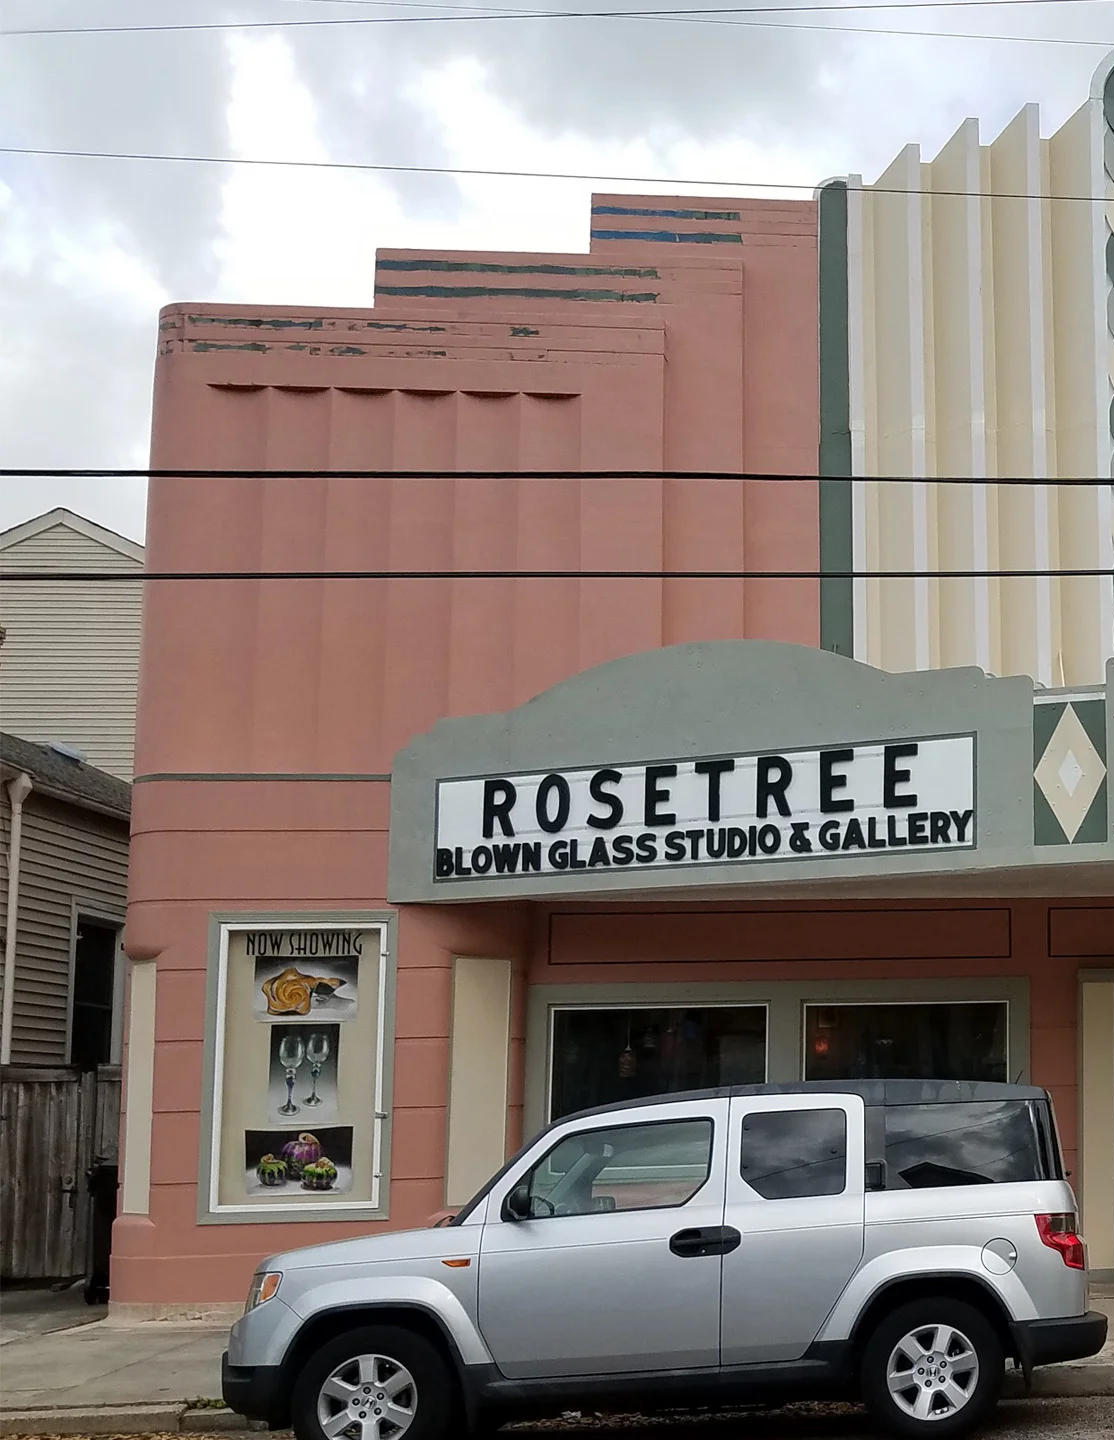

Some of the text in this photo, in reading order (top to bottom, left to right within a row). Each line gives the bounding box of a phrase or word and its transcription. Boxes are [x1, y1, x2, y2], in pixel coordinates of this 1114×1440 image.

[482, 743, 919, 839] ROSETREE
[436, 810, 974, 877] BLOWN GLASS STUDIO & GALLERY
[246, 932, 363, 956] NOW SHOWING
